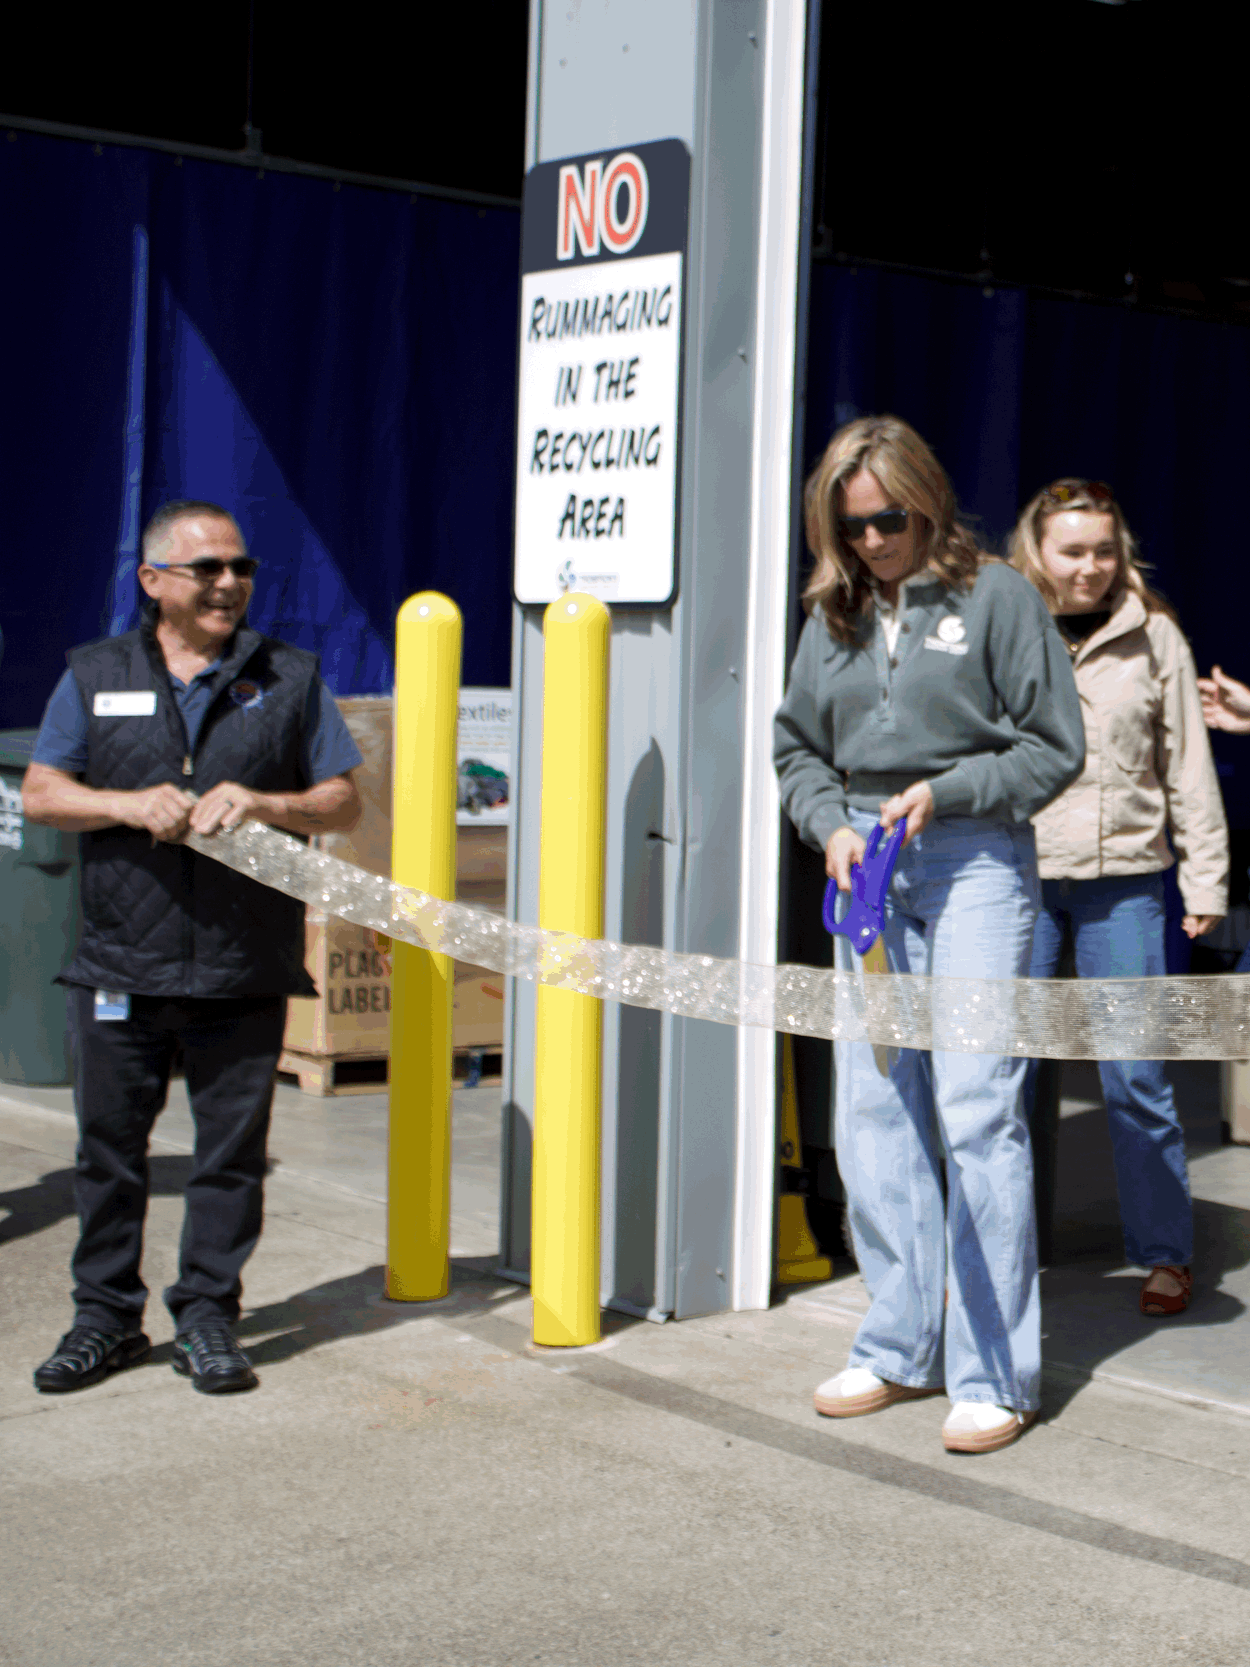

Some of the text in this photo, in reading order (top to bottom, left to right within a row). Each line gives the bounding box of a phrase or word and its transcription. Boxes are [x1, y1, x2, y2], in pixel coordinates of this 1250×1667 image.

[556, 152, 650, 261] NO
[527, 284, 673, 343] RUMMAGING
[555, 356, 640, 408] IN THE
[529, 424, 661, 475] RECYCLING
[557, 493, 626, 540] AREA
[459, 700, 513, 723] extile
